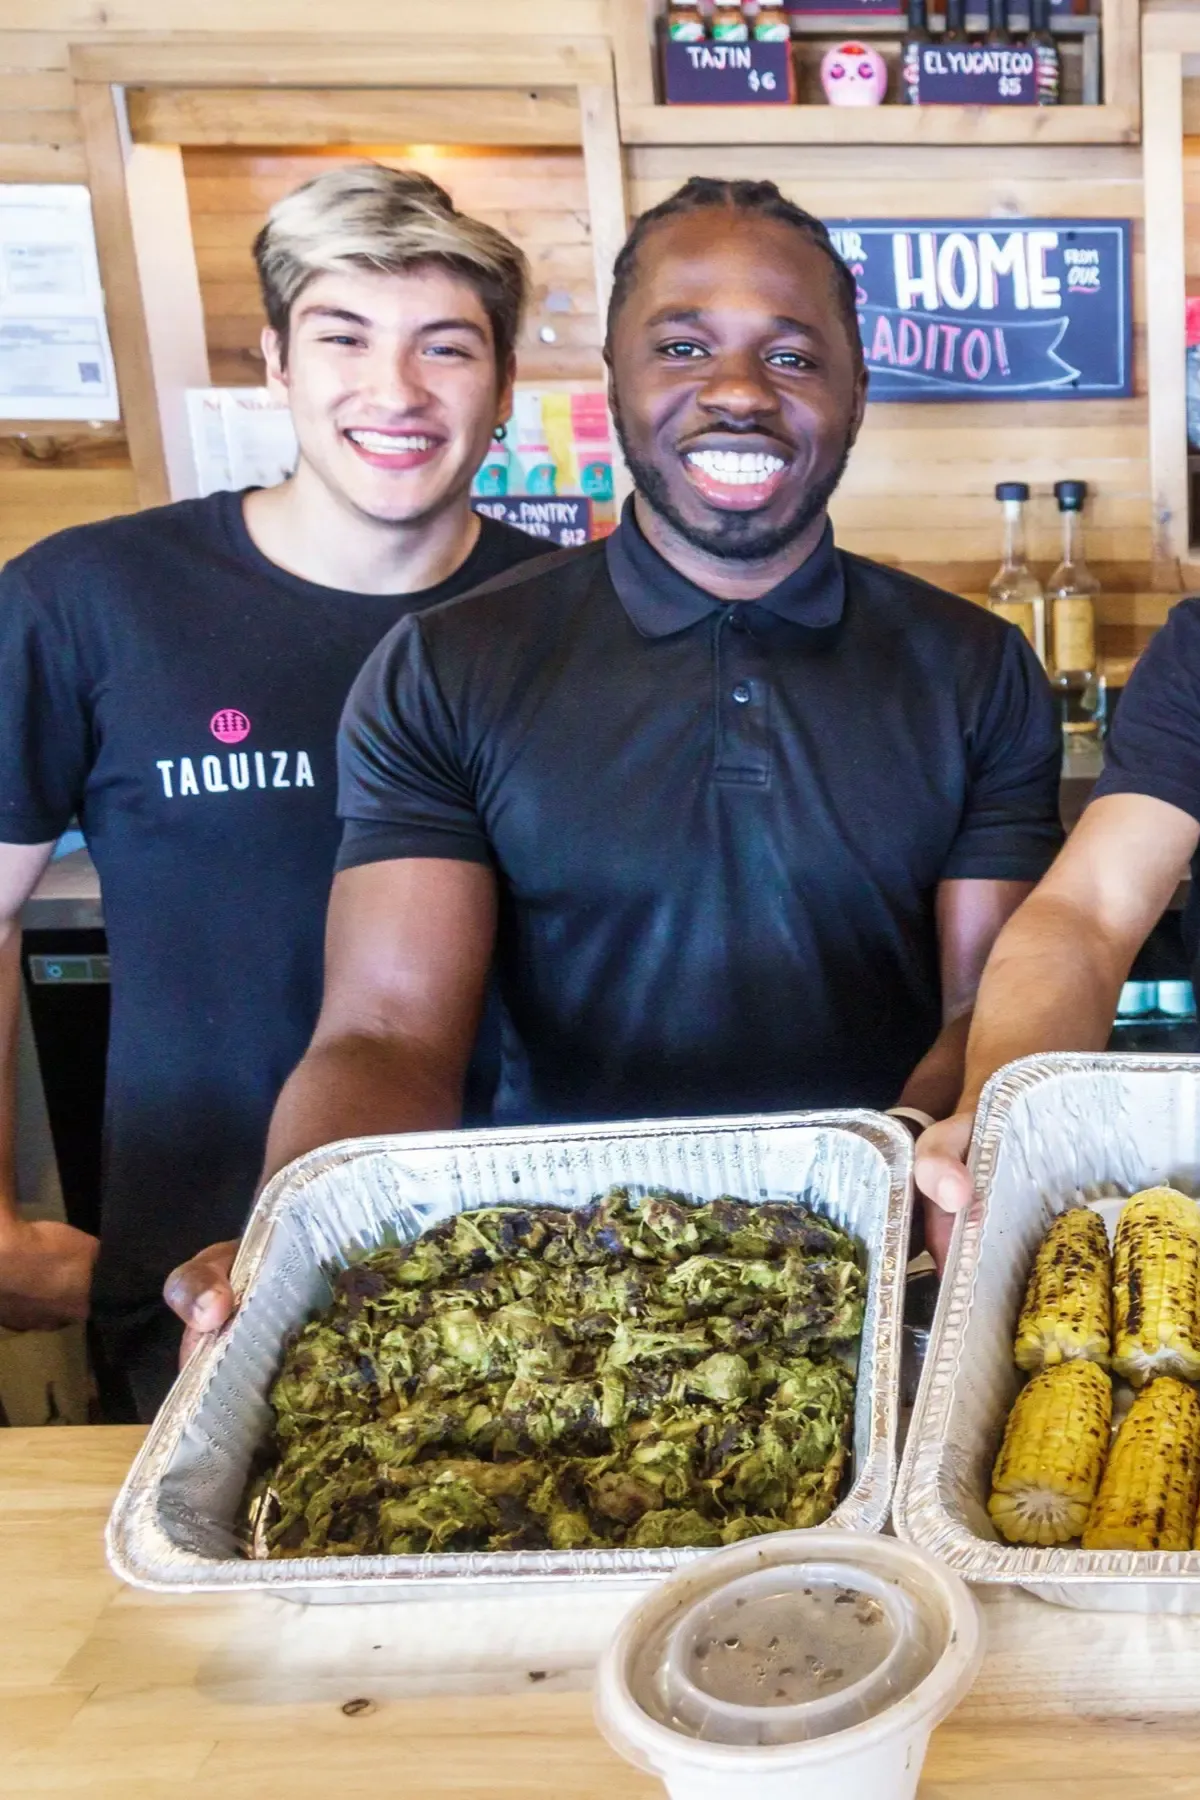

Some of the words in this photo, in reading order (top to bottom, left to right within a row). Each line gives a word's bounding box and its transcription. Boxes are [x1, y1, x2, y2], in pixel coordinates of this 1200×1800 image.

[686, 46, 751, 69] TAJIN
[924, 51, 948, 74] EL
[946, 51, 1034, 75] YUCATECO
[747, 69, 776, 91] $6
[1063, 248, 1100, 266] FROM
[892, 231, 1062, 311] HOME
[1067, 265, 1101, 286] OUR
[860, 315, 1011, 381] ADITO!
[519, 502, 578, 524] PANTRY
[156, 751, 316, 798] TAQUIZA
